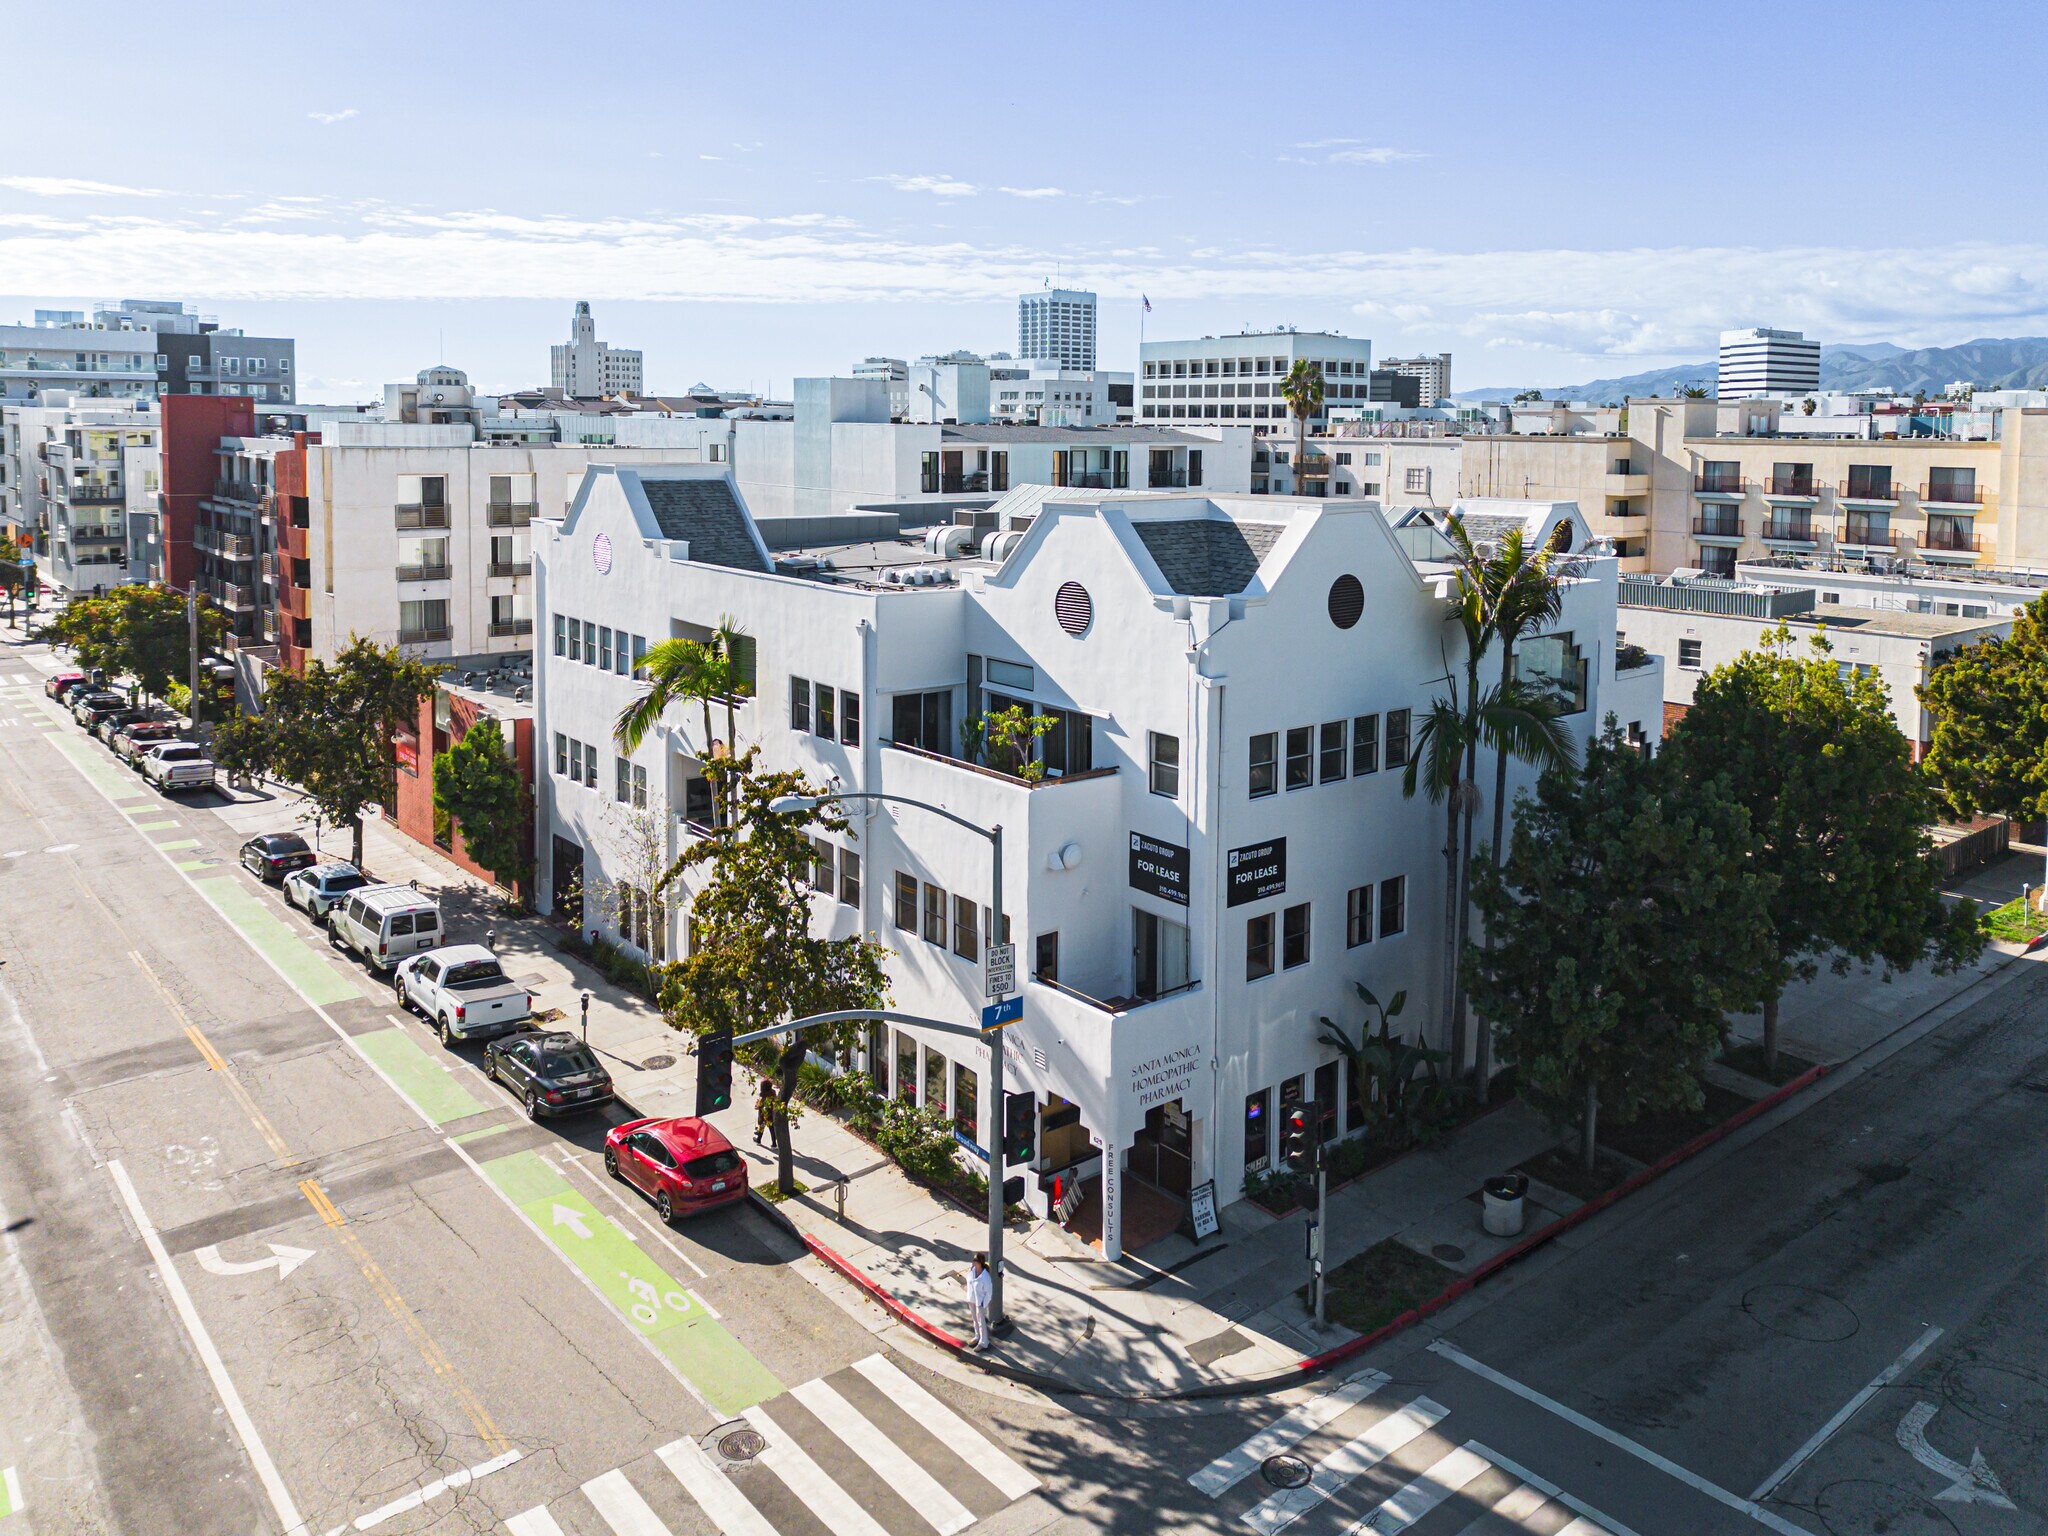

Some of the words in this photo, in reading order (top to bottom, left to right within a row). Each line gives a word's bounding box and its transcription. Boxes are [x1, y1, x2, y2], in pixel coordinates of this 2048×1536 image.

[1141, 840, 1159, 854] ZACUTO
[1159, 846, 1175, 859] GROUP
[1239, 851, 1257, 862] ZACUTO
[1257, 846, 1273, 858] GROUP
[1137, 859, 1154, 874] FOR
[1156, 865, 1180, 883] LEASE
[1235, 871, 1253, 885] FOR
[1254, 865, 1278, 880] LEASE
[988, 964, 1013, 973] INTERSECTION
[990, 956, 1010, 967] BLOCK
[989, 975, 1003, 984] FINES
[1005, 973, 1011, 981] TO
[992, 982, 1009, 993] $500
[994, 1003, 1011, 1020] 7th
[1131, 1058, 1161, 1078] SANTA
[1162, 1044, 1201, 1066] MONICA
[1132, 1059, 1200, 1093] HOMEOPATHIC
[1139, 1077, 1192, 1106] PHARMACY
[955, 1131, 980, 1155] Broadway
